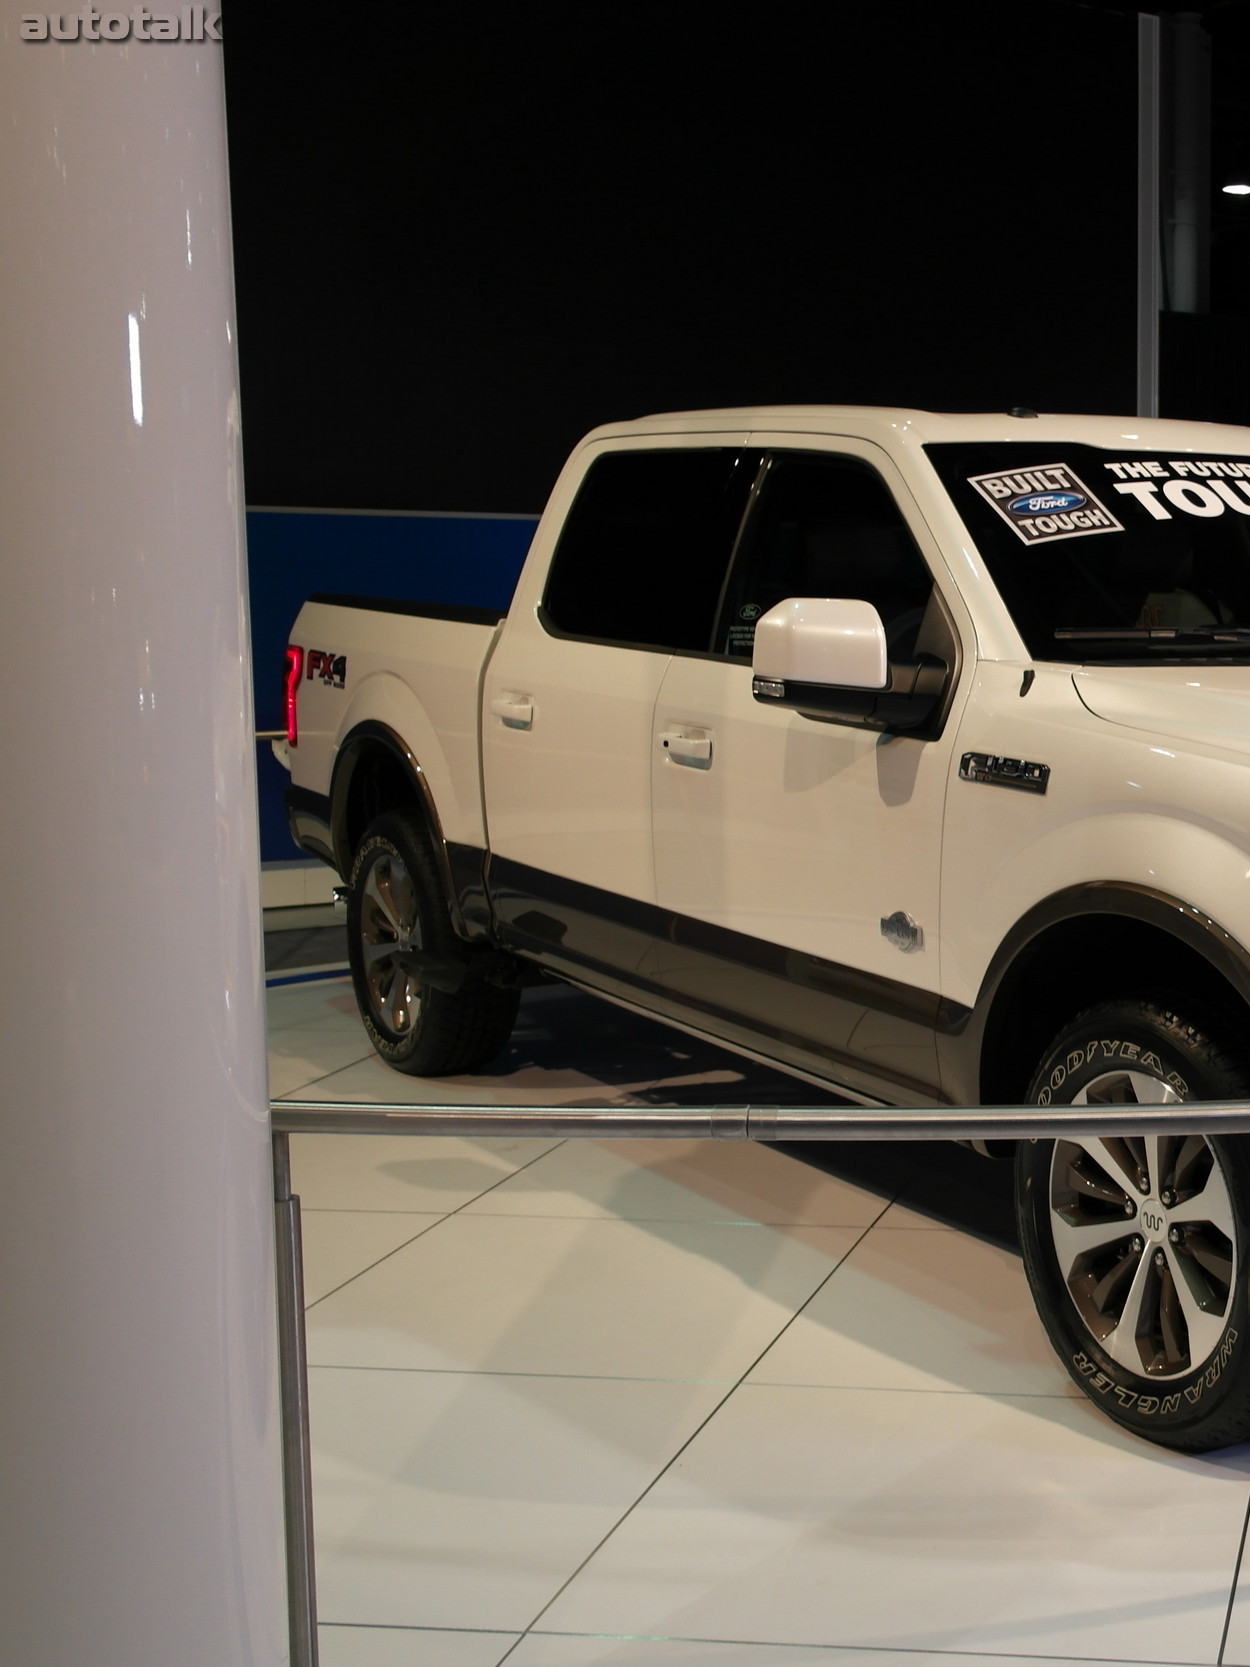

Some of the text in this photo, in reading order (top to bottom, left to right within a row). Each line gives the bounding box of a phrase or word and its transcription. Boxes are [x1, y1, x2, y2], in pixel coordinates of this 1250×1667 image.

[981, 469, 1068, 499] BUILT
[1104, 461, 1169, 479] THE
[1028, 495, 1069, 511] Ford
[1017, 509, 1112, 537] TOUGH
[306, 649, 347, 683] FX4
[1029, 1039, 1190, 1144] OODYEAR
[1072, 1326, 1239, 1416] WRANGLER
